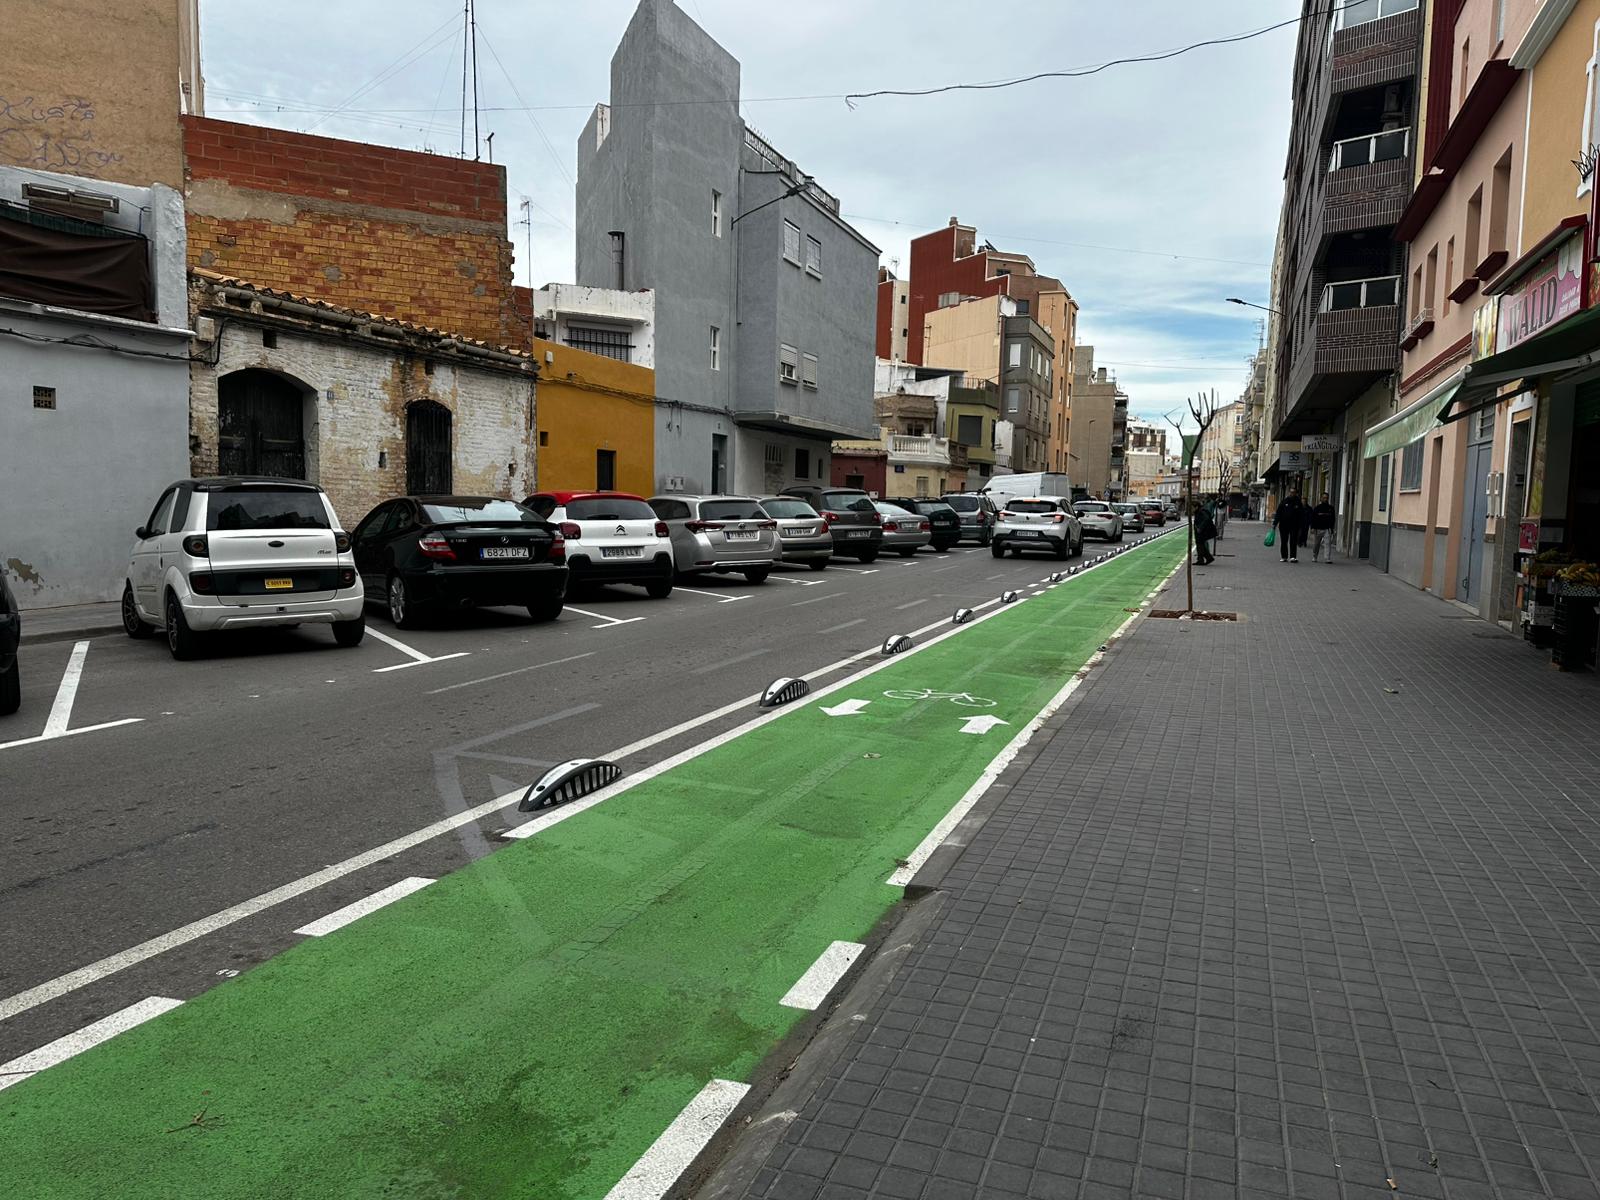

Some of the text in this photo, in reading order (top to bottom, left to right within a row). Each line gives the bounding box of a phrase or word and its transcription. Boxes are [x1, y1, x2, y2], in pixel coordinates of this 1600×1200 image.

[1508, 276, 1558, 346] WALID
[487, 547, 528, 557] 6821 DFZ
